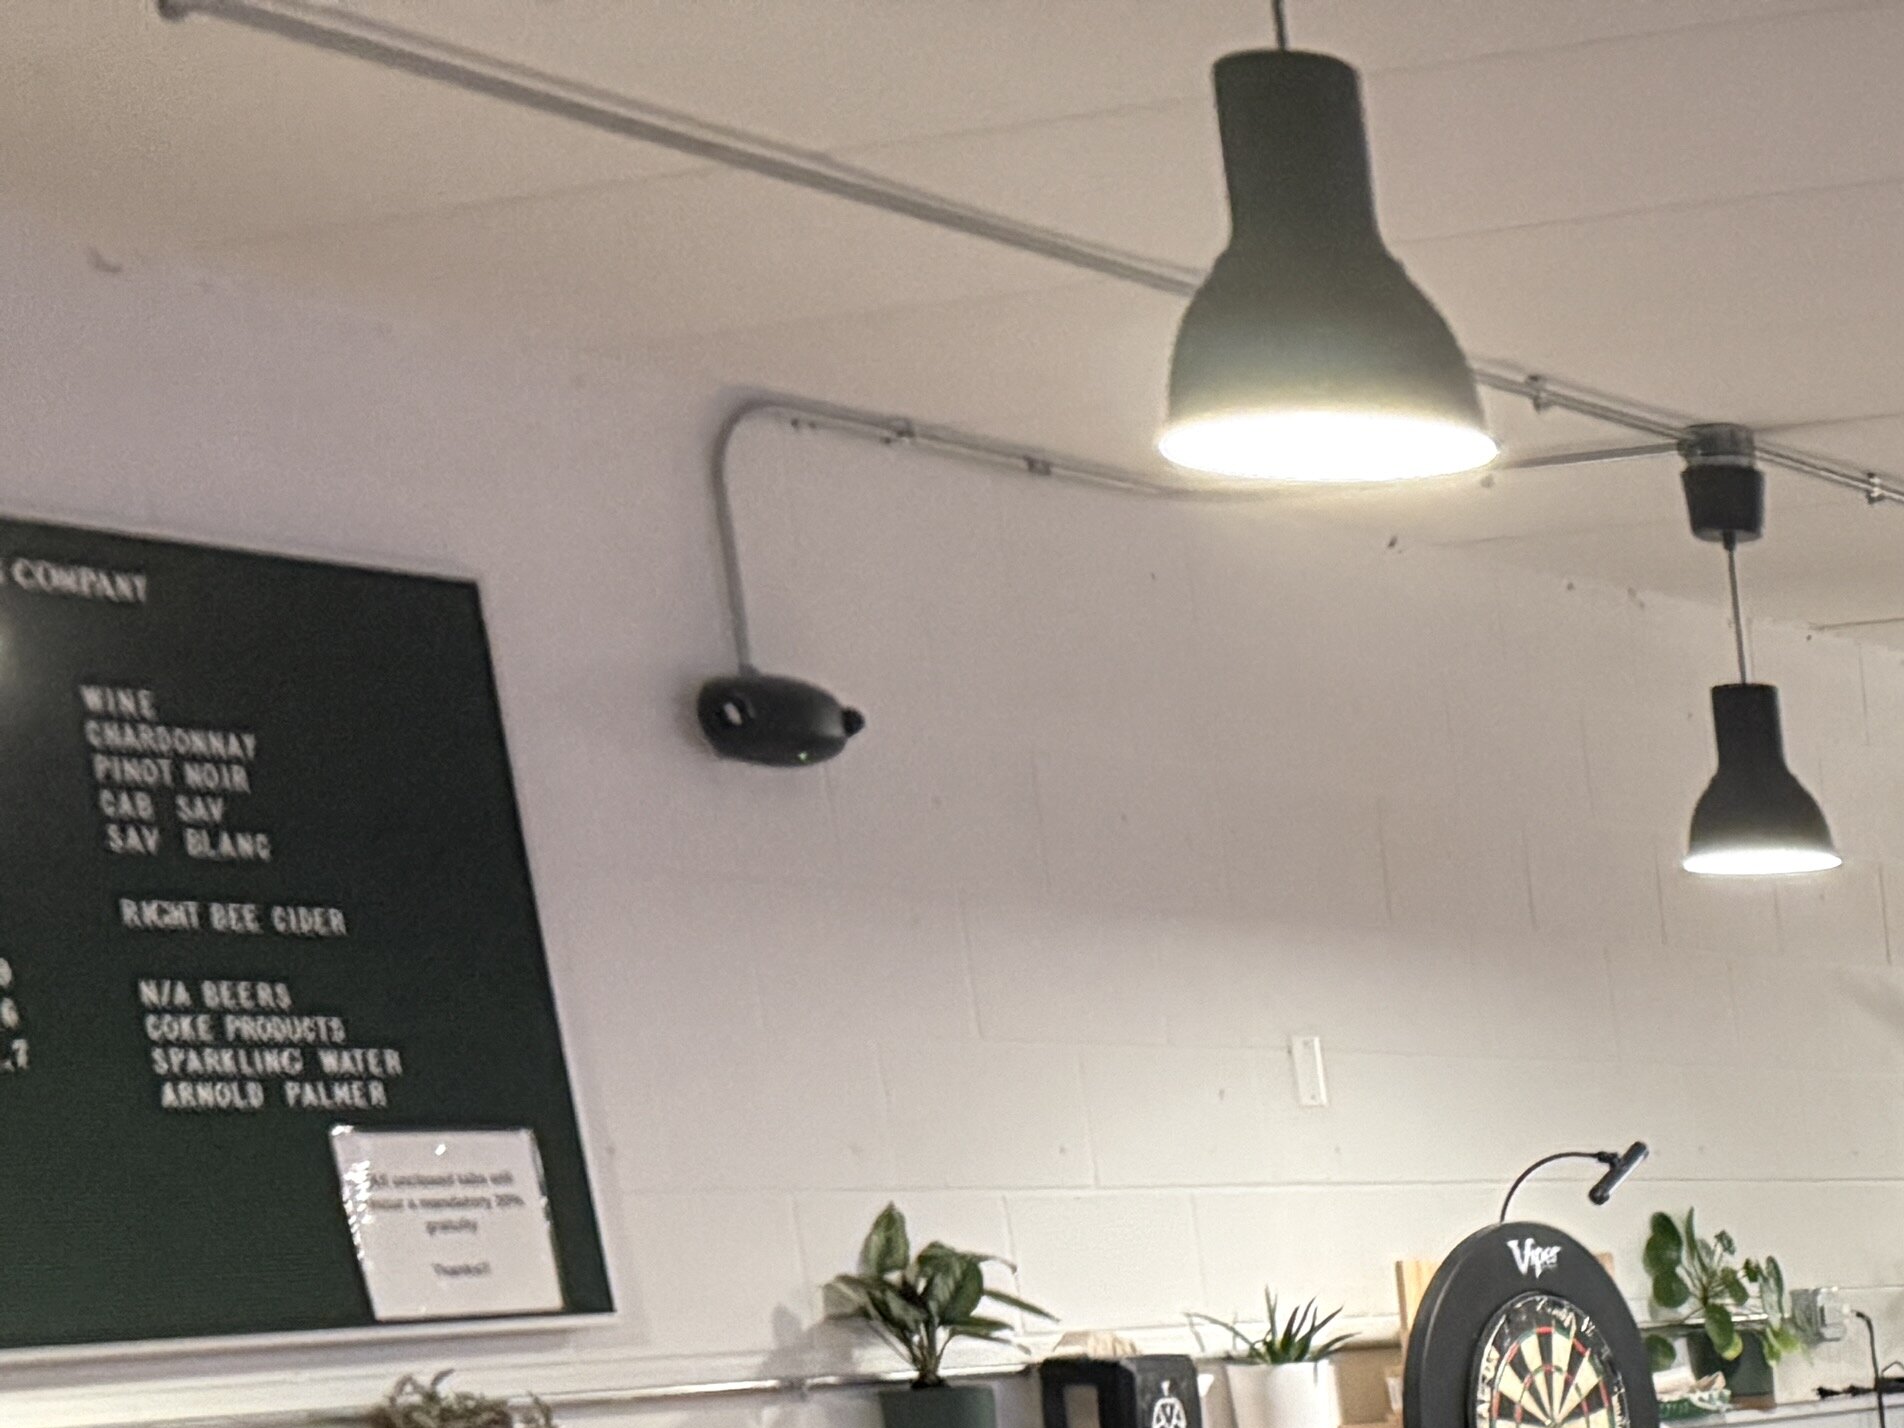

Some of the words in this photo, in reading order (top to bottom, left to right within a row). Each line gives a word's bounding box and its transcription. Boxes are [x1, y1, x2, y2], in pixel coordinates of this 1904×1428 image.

[11, 556, 147, 602] COMPANY
[79, 684, 157, 721] WINE
[85, 719, 255, 760] CHARDONNAY
[93, 753, 173, 788] PINOT
[182, 760, 251, 794] NOIR
[175, 794, 225, 824] SAV
[105, 822, 159, 856] SAV
[209, 902, 263, 935] BEE
[270, 906, 348, 936] CIDER
[201, 980, 293, 1010] BEERS
[144, 1012, 213, 1042] COKE
[223, 1014, 347, 1045] PRODUCTS
[150, 1046, 303, 1077] SPARKLING
[318, 1047, 402, 1078] WATER
[161, 1081, 265, 1110] ARNOLD
[284, 1080, 388, 1109] PALMER
